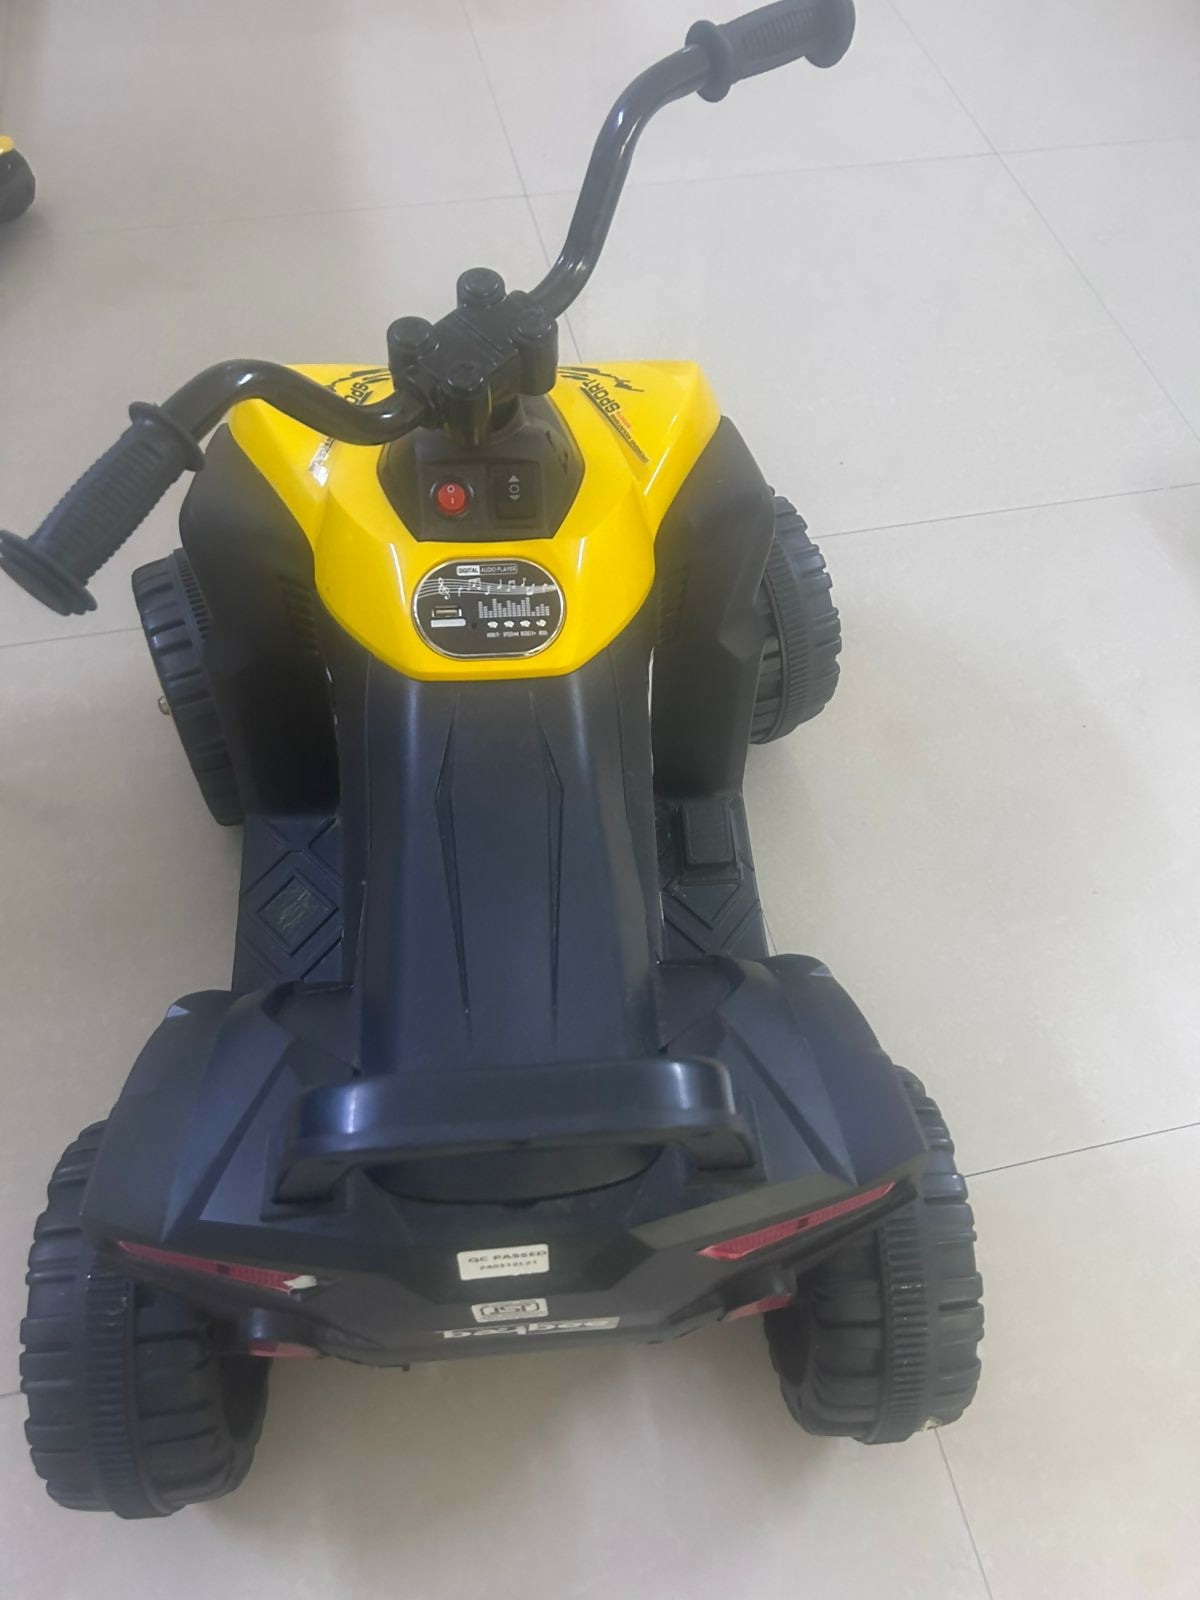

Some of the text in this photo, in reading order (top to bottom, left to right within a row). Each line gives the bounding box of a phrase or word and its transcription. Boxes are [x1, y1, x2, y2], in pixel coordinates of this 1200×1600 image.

[581, 379, 621, 414] SPORT
[458, 564, 517, 574] DIGITAL AUDIO PLAYER
[468, 1249, 548, 1263] QC PASSED
